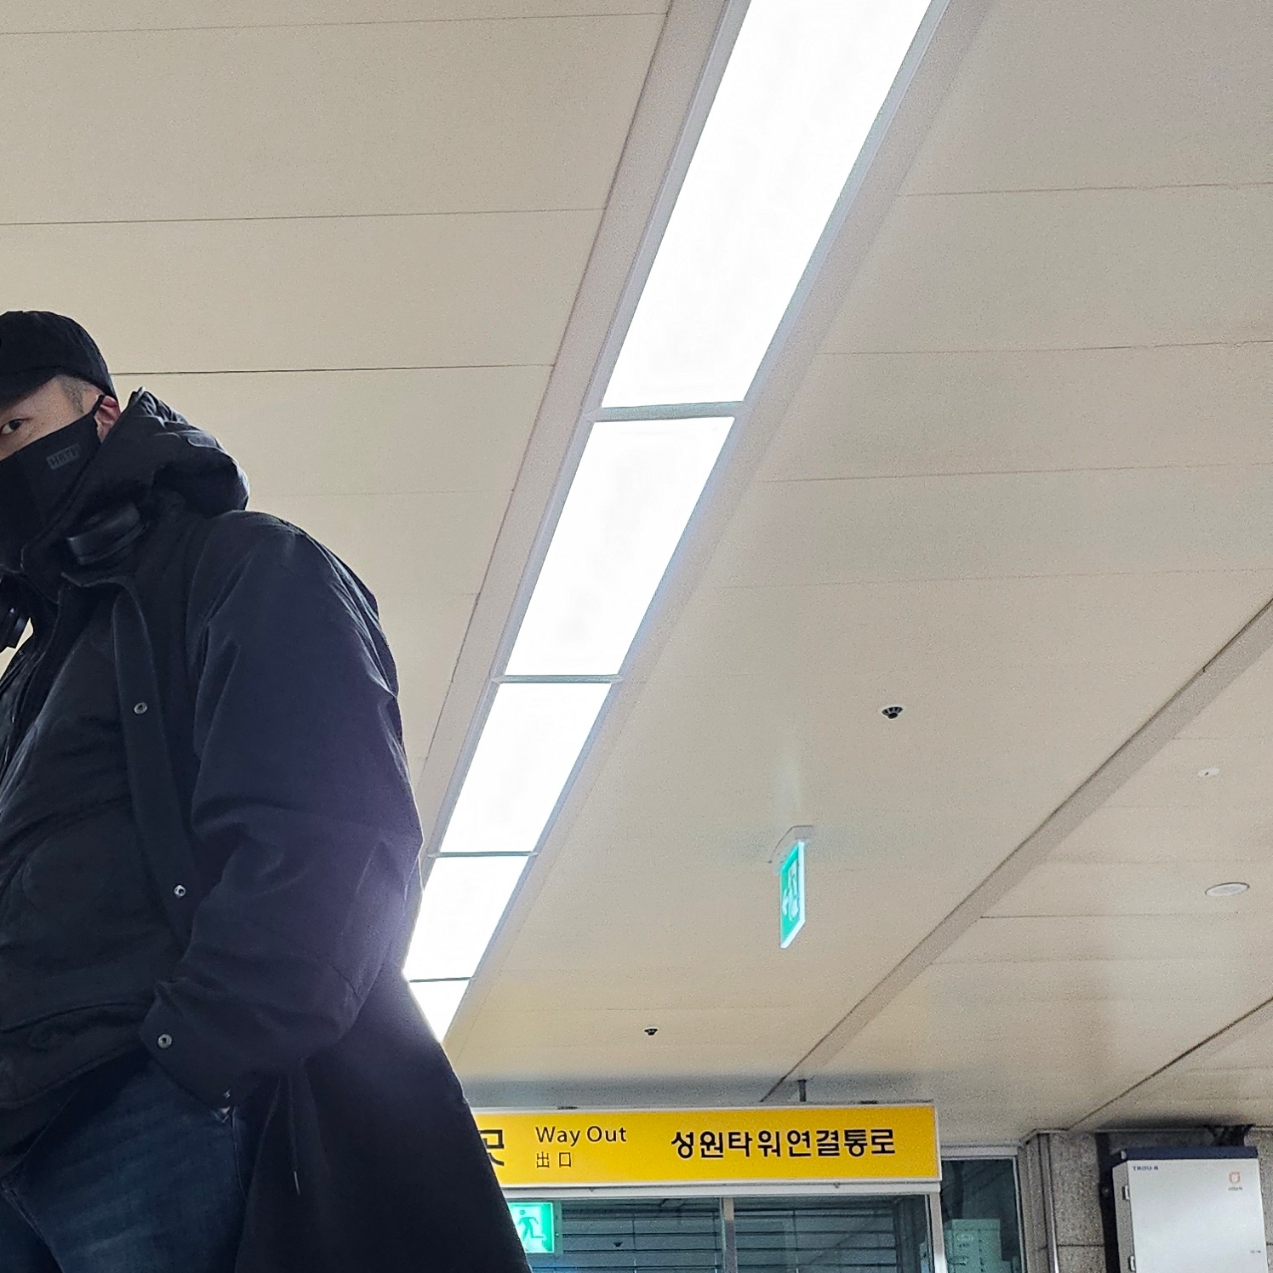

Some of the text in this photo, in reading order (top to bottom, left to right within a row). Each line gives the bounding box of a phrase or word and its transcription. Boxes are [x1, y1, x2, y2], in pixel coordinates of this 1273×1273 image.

[535, 1125, 626, 1147] Way Out
[671, 1129, 896, 1159] 성원타워연결통로
[536, 1151, 572, 1168] 出口
